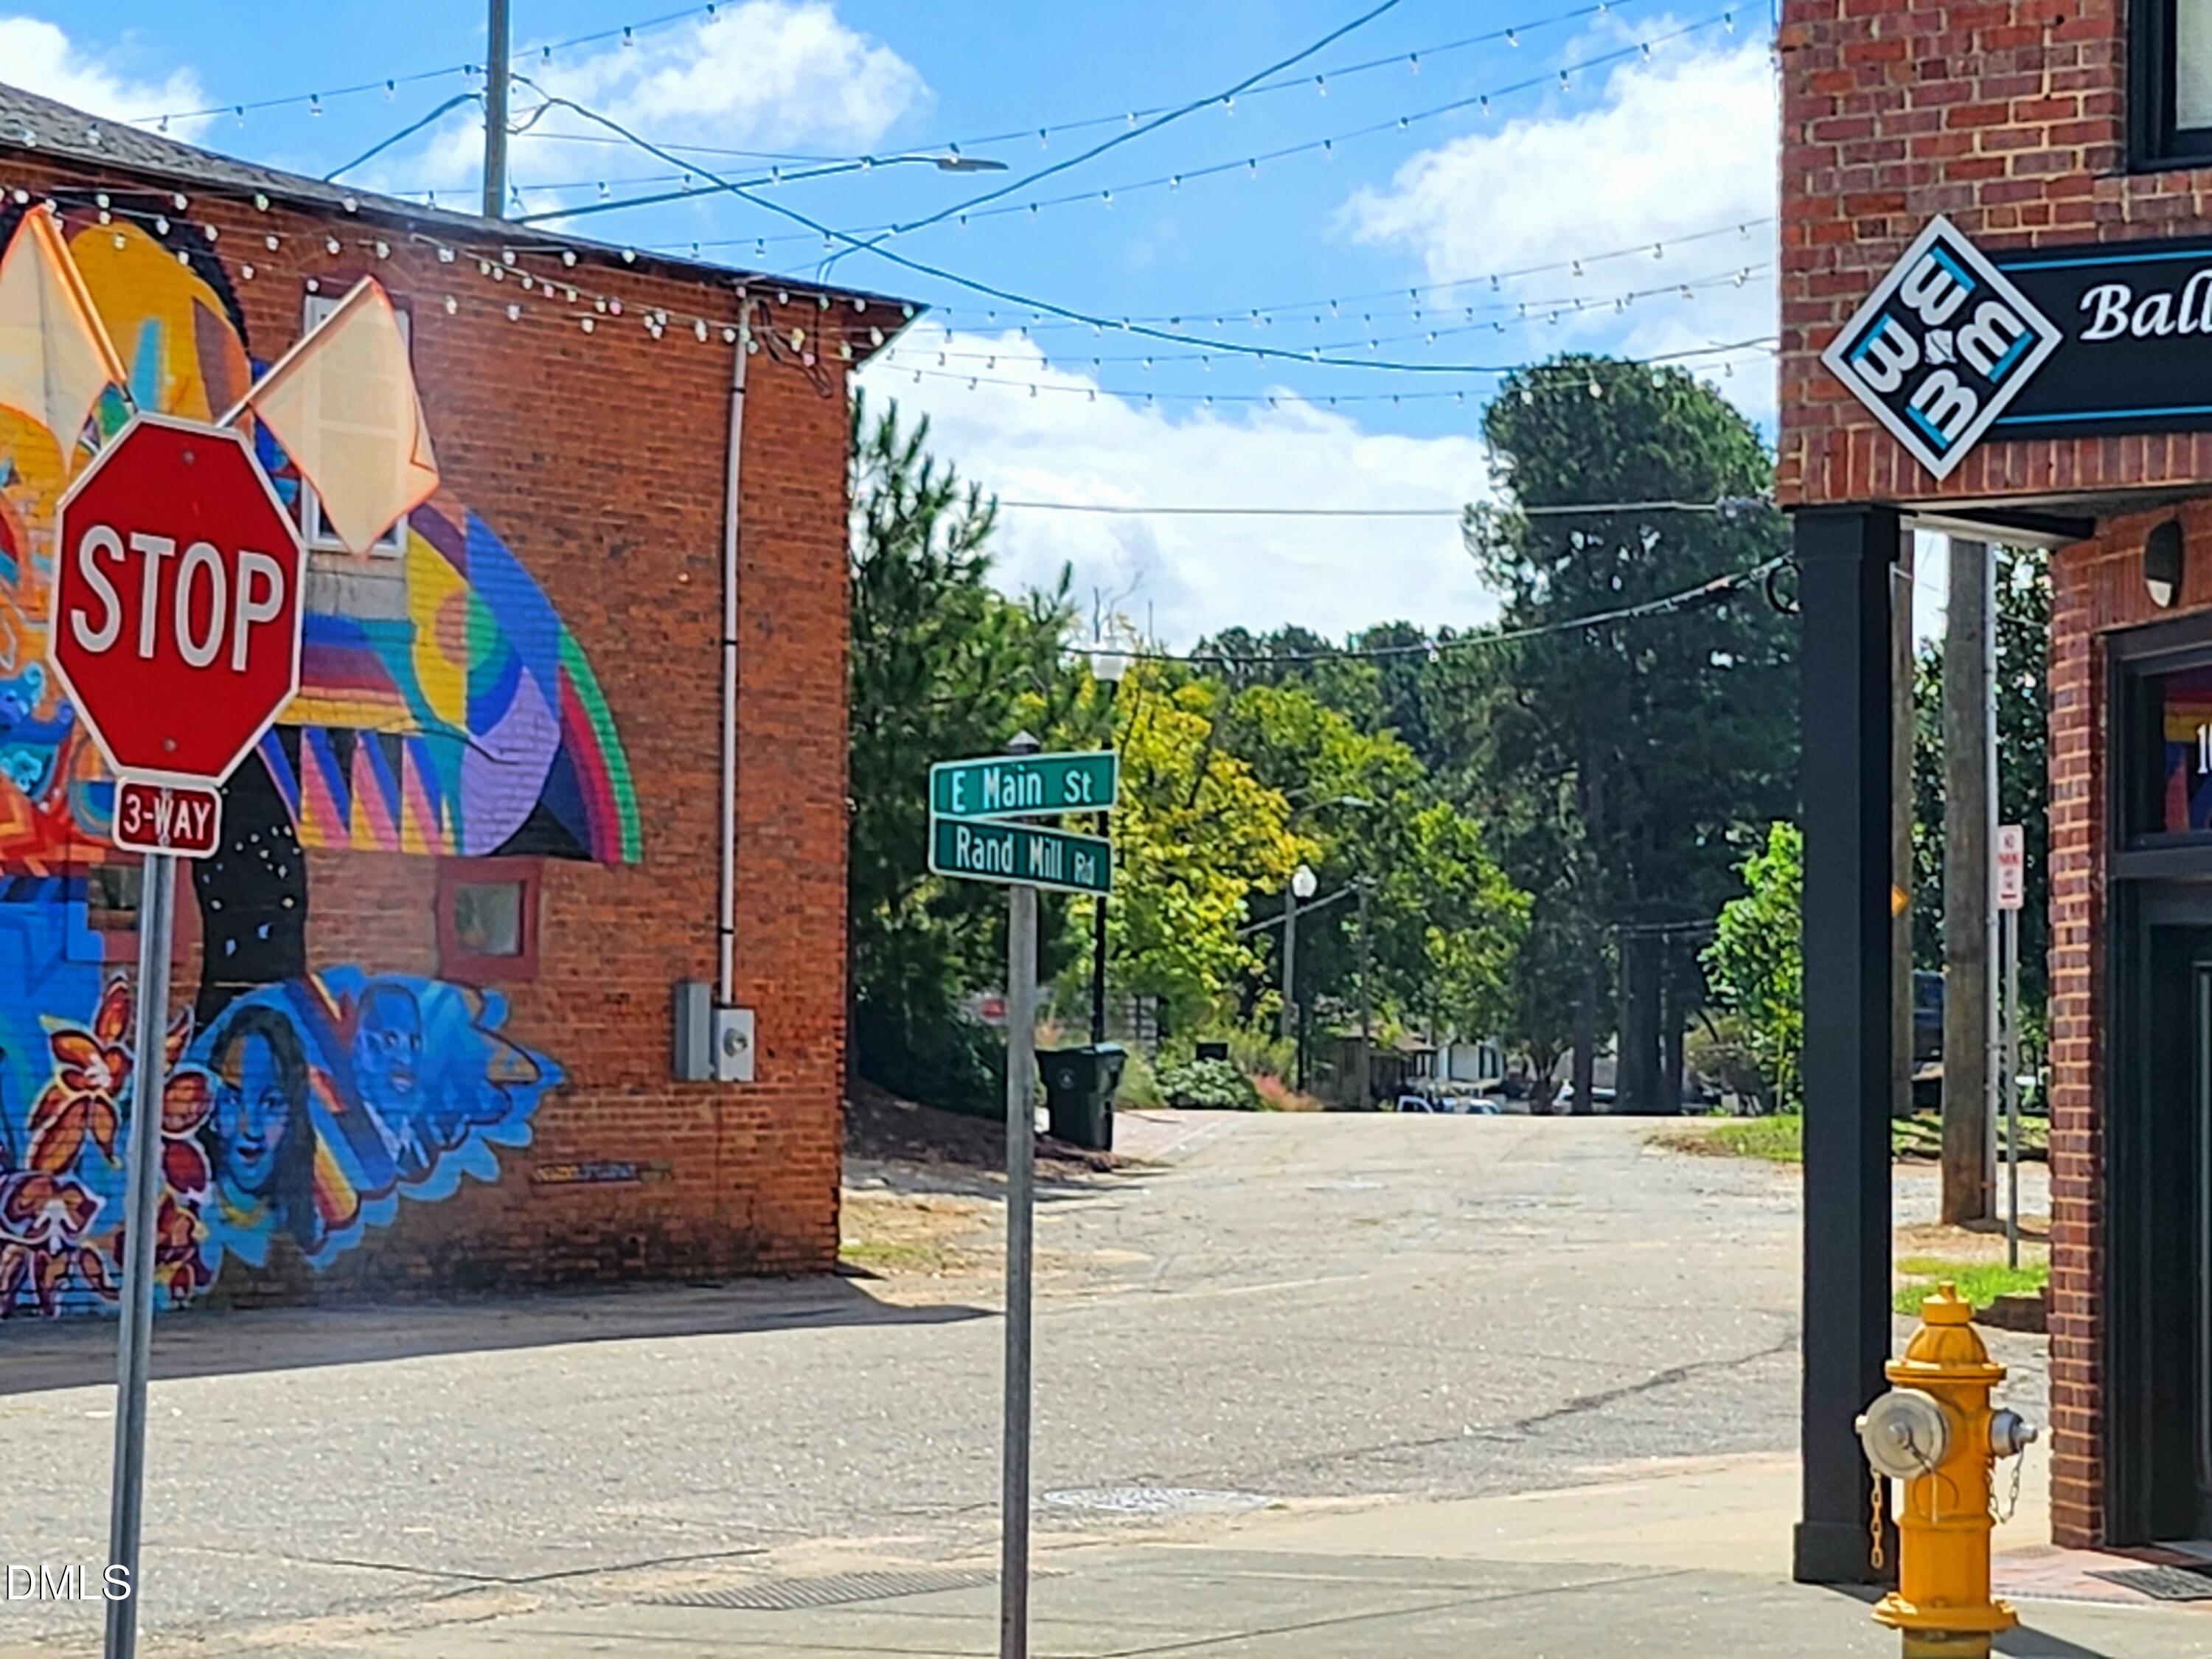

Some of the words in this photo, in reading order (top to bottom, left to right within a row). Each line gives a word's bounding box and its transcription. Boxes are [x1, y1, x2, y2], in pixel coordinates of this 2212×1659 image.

[71, 525, 285, 672] STOP
[952, 771, 967, 812] E
[984, 765, 1042, 810] Main
[1064, 771, 1092, 803] St
[123, 793, 212, 841] 3-WAY
[956, 825, 1014, 874] Rand
[1029, 836, 1062, 880] Mill
[1074, 852, 1095, 885] Rd
